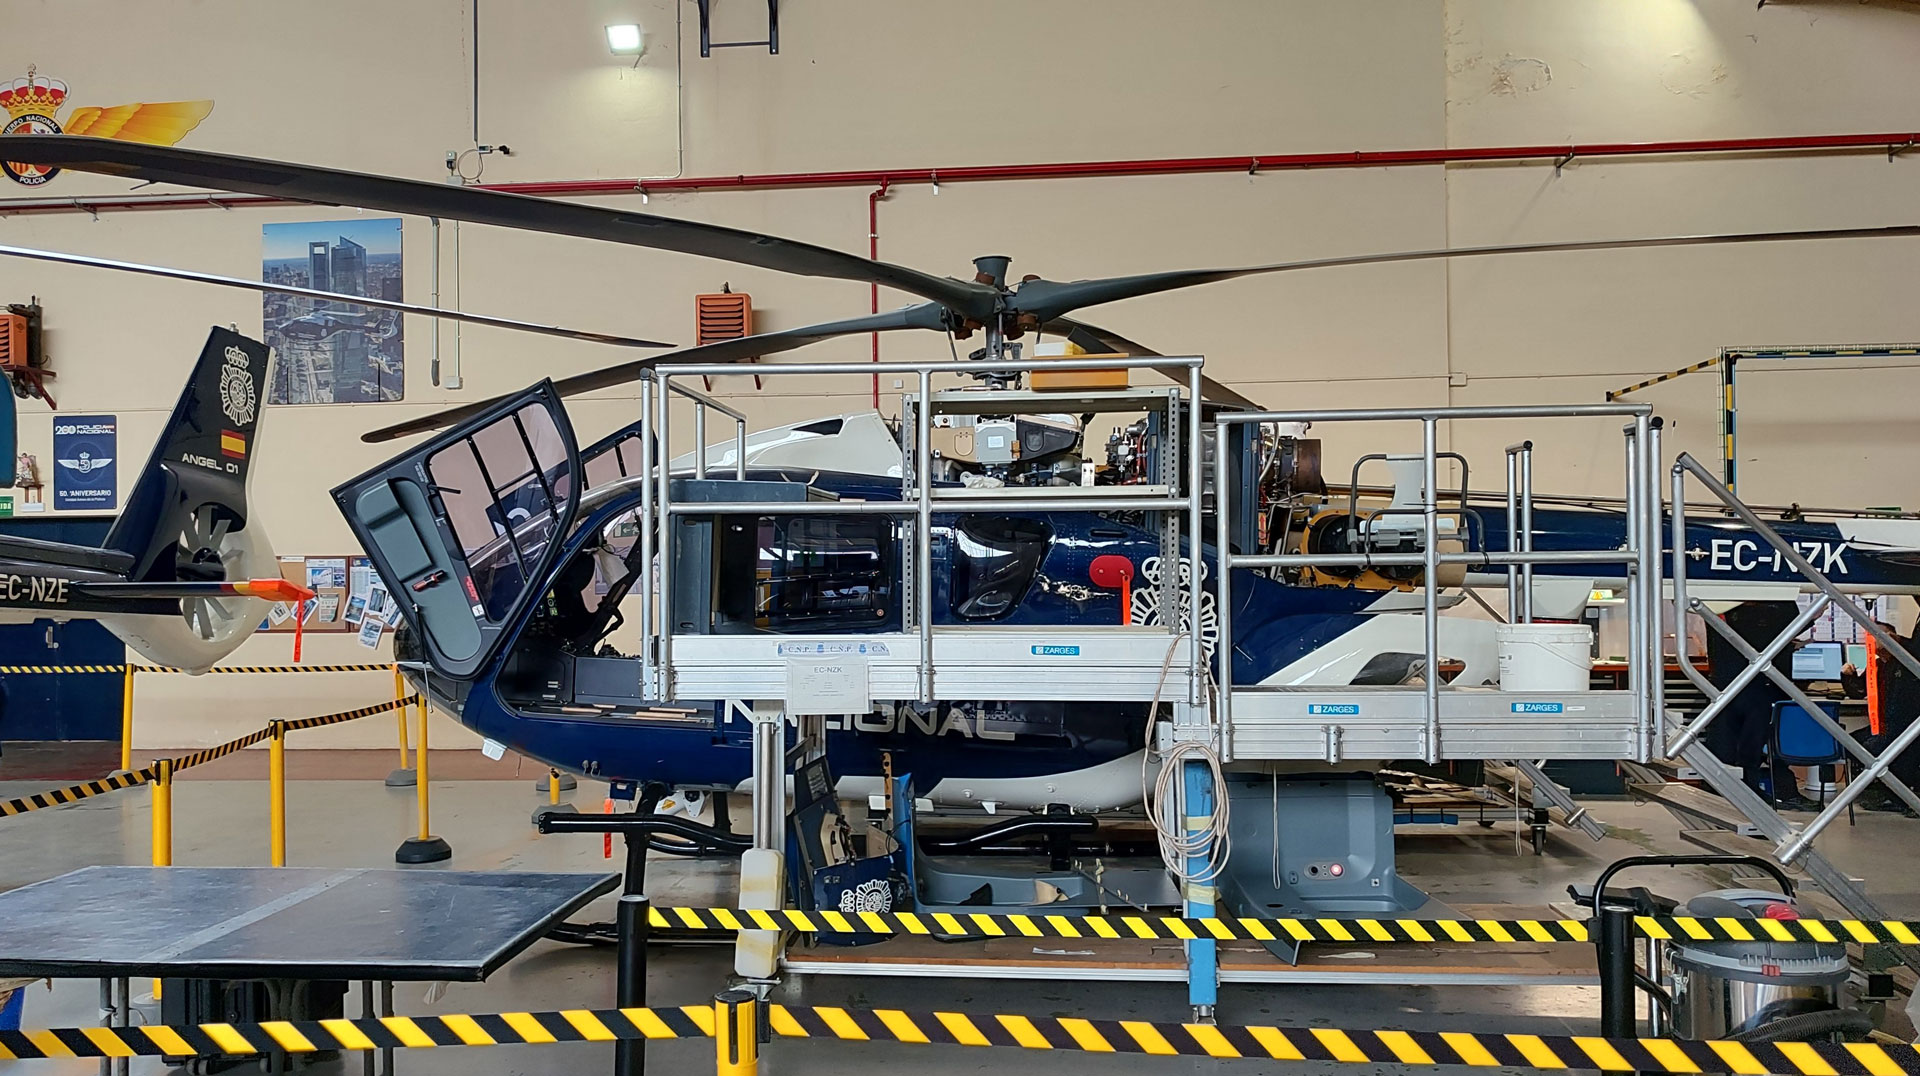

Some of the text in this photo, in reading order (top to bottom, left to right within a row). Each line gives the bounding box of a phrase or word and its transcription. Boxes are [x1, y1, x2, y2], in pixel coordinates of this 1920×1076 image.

[26, 115, 57, 132] NACIONAL
[55, 425, 76, 435] 200
[182, 452, 239, 475] ANGEL 01
[1045, 646, 1075, 655] ZARGES
[1322, 705, 1355, 714] ZARGES
[1525, 703, 1558, 712] ZARGES
[724, 700, 1015, 741] NIONAL
